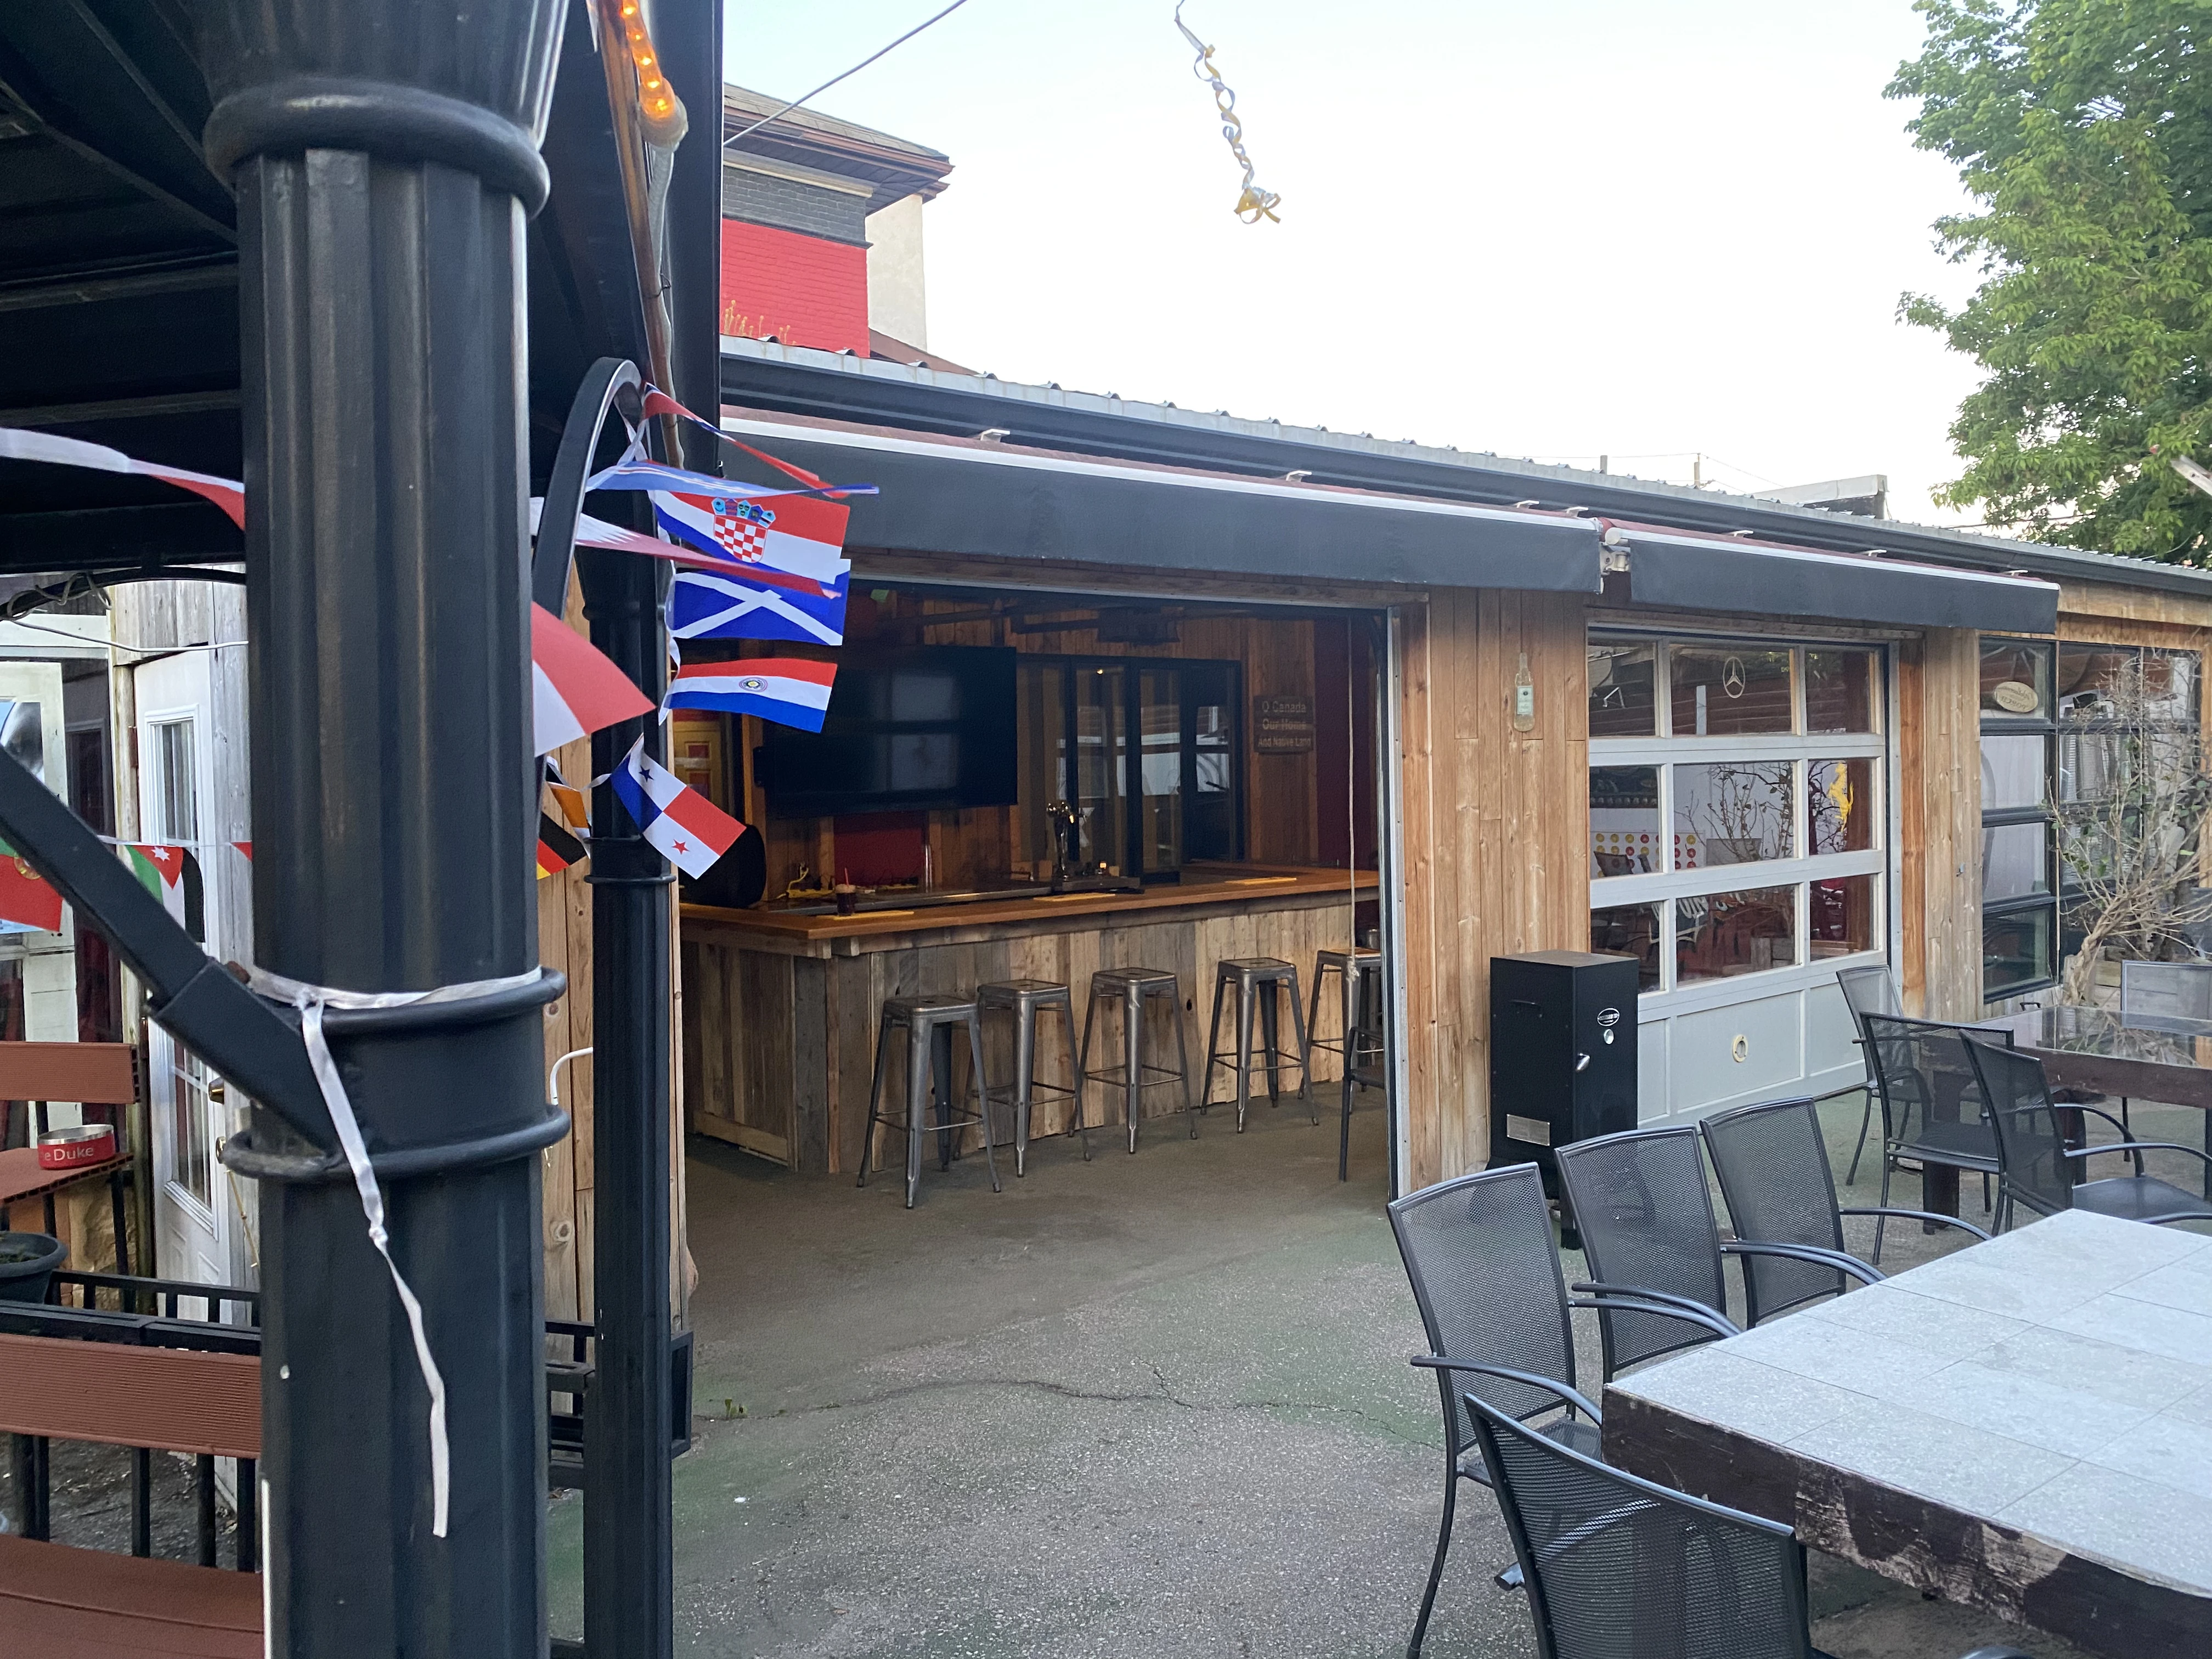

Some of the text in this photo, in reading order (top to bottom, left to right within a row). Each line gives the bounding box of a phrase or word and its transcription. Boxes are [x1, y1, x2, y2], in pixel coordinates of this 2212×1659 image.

[1262, 701, 1306, 713] O Canada
[1263, 718, 1279, 730] Our
[1295, 737, 1311, 747] Land
[53, 1147, 94, 1161] Duke
